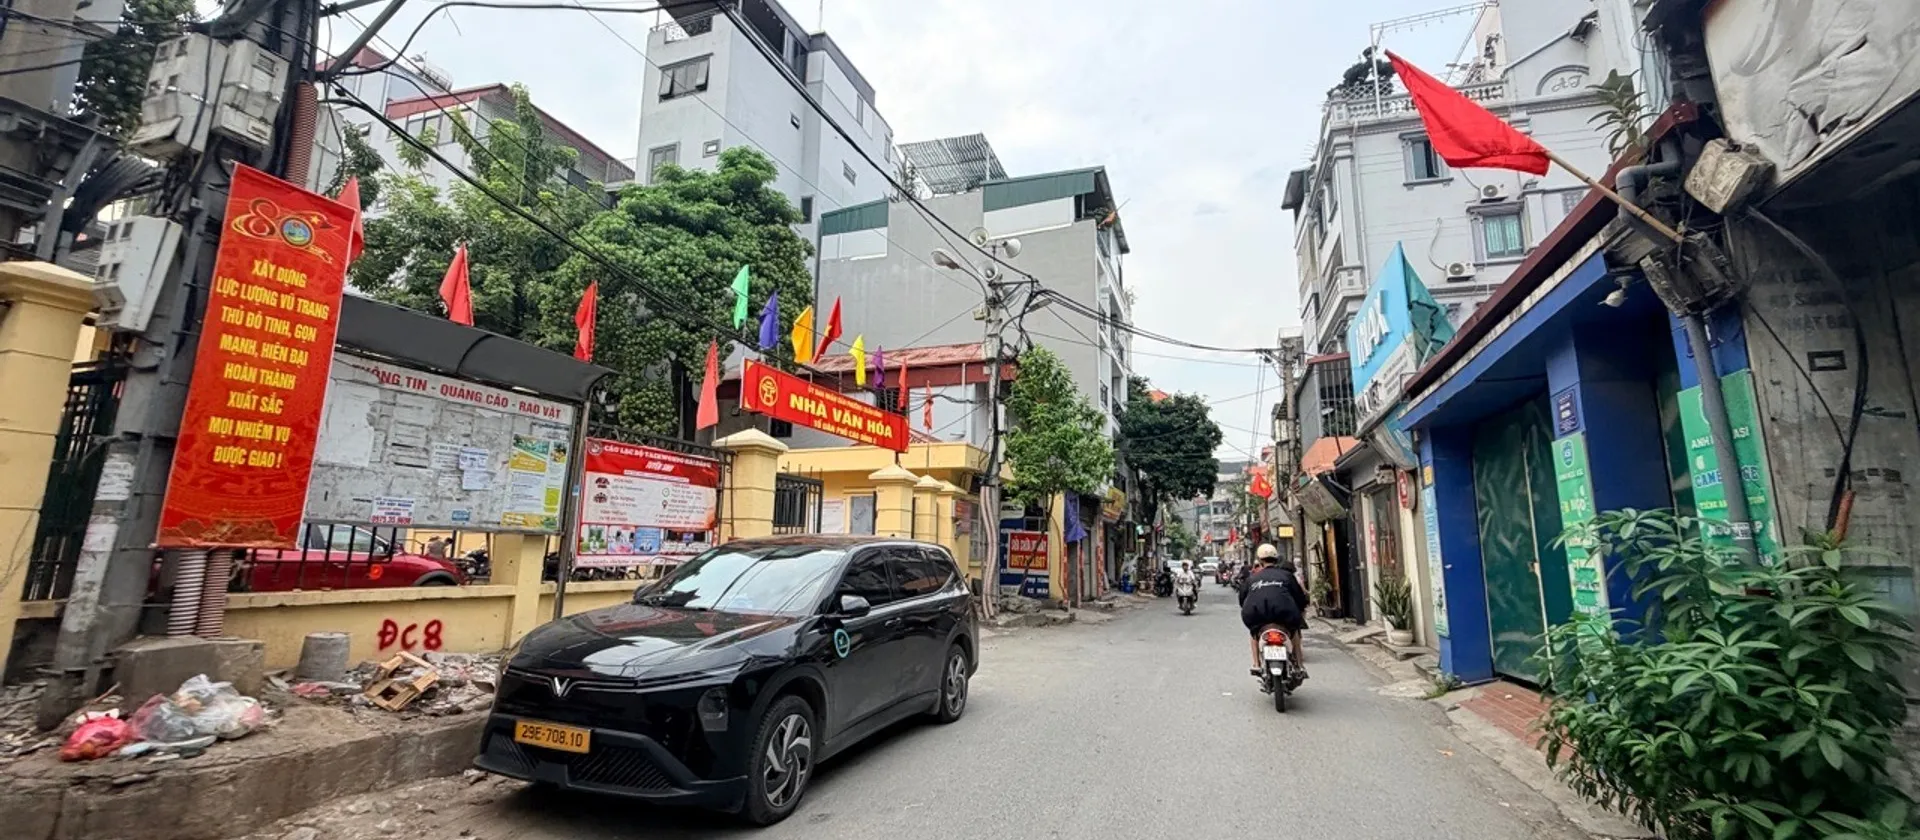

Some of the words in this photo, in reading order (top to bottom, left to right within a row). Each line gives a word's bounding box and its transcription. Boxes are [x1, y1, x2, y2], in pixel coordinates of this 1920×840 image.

[252, 259, 277, 279] XÂY
[277, 266, 308, 288] DỰNG
[216, 276, 239, 298] LỰC
[240, 283, 278, 305] LƯỢNG
[297, 298, 329, 320] TRANG
[222, 304, 244, 325] THỦ
[294, 323, 317, 343] GỌN
[220, 333, 258, 358] MẠNH,
[261, 341, 289, 364] HIỆN
[289, 347, 308, 369] ĐẠI
[223, 361, 258, 384] HOÀN
[260, 368, 296, 391] THÀNH
[352, 363, 401, 385] ÔNG
[405, 376, 427, 391] TIN
[440, 382, 482, 402] QUẢNG
[519, 401, 540, 415] RAO
[227, 388, 259, 411] XUẤT
[260, 391, 284, 415] SẮC
[789, 393, 828, 419] NHÀ
[832, 406, 863, 430] VĂN
[867, 417, 893, 438] HÓA
[208, 415, 234, 438] MỌI
[235, 419, 273, 442] NHIỆM
[275, 425, 291, 446] VỤ
[212, 445, 247, 468] ĐƯỢC
[248, 450, 276, 468] GIAO
[521, 724, 584, 747] 29E-708.10
